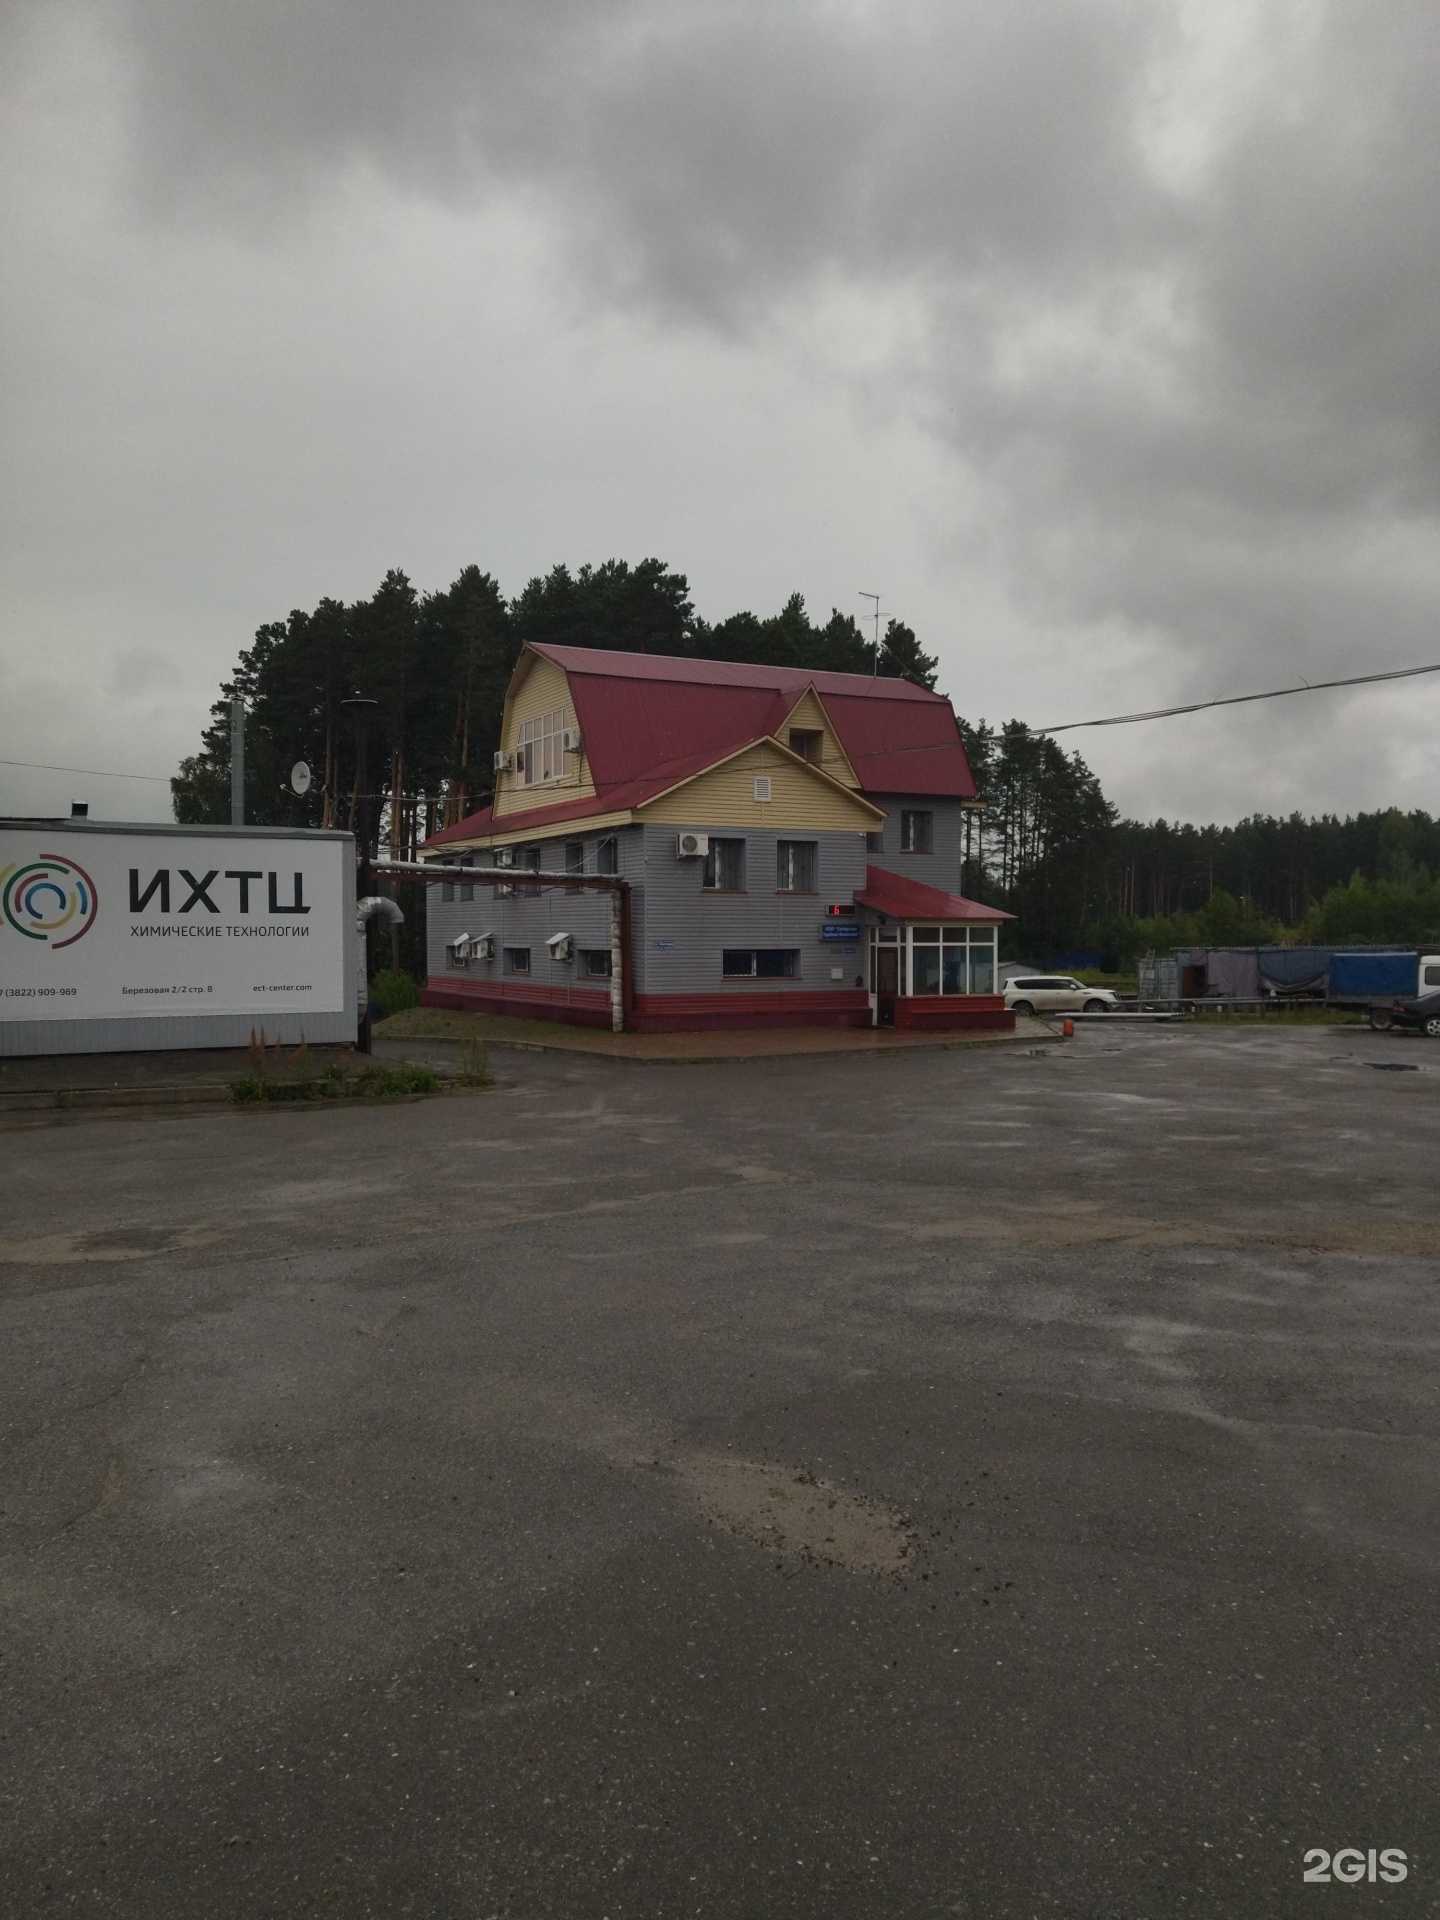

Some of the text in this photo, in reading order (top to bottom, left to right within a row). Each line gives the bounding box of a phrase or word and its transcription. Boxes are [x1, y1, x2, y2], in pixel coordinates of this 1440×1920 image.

[129, 868, 311, 914] ИХТЦ
[130, 925, 310, 937] ХИМИЧЕСКИЕ ТЕХНОЛОГИИ
[5, 988, 36, 997] (3822)
[122, 986, 170, 996] Березовая
[171, 985, 187, 994] 2/2
[252, 984, 312, 992] ect-center.com
